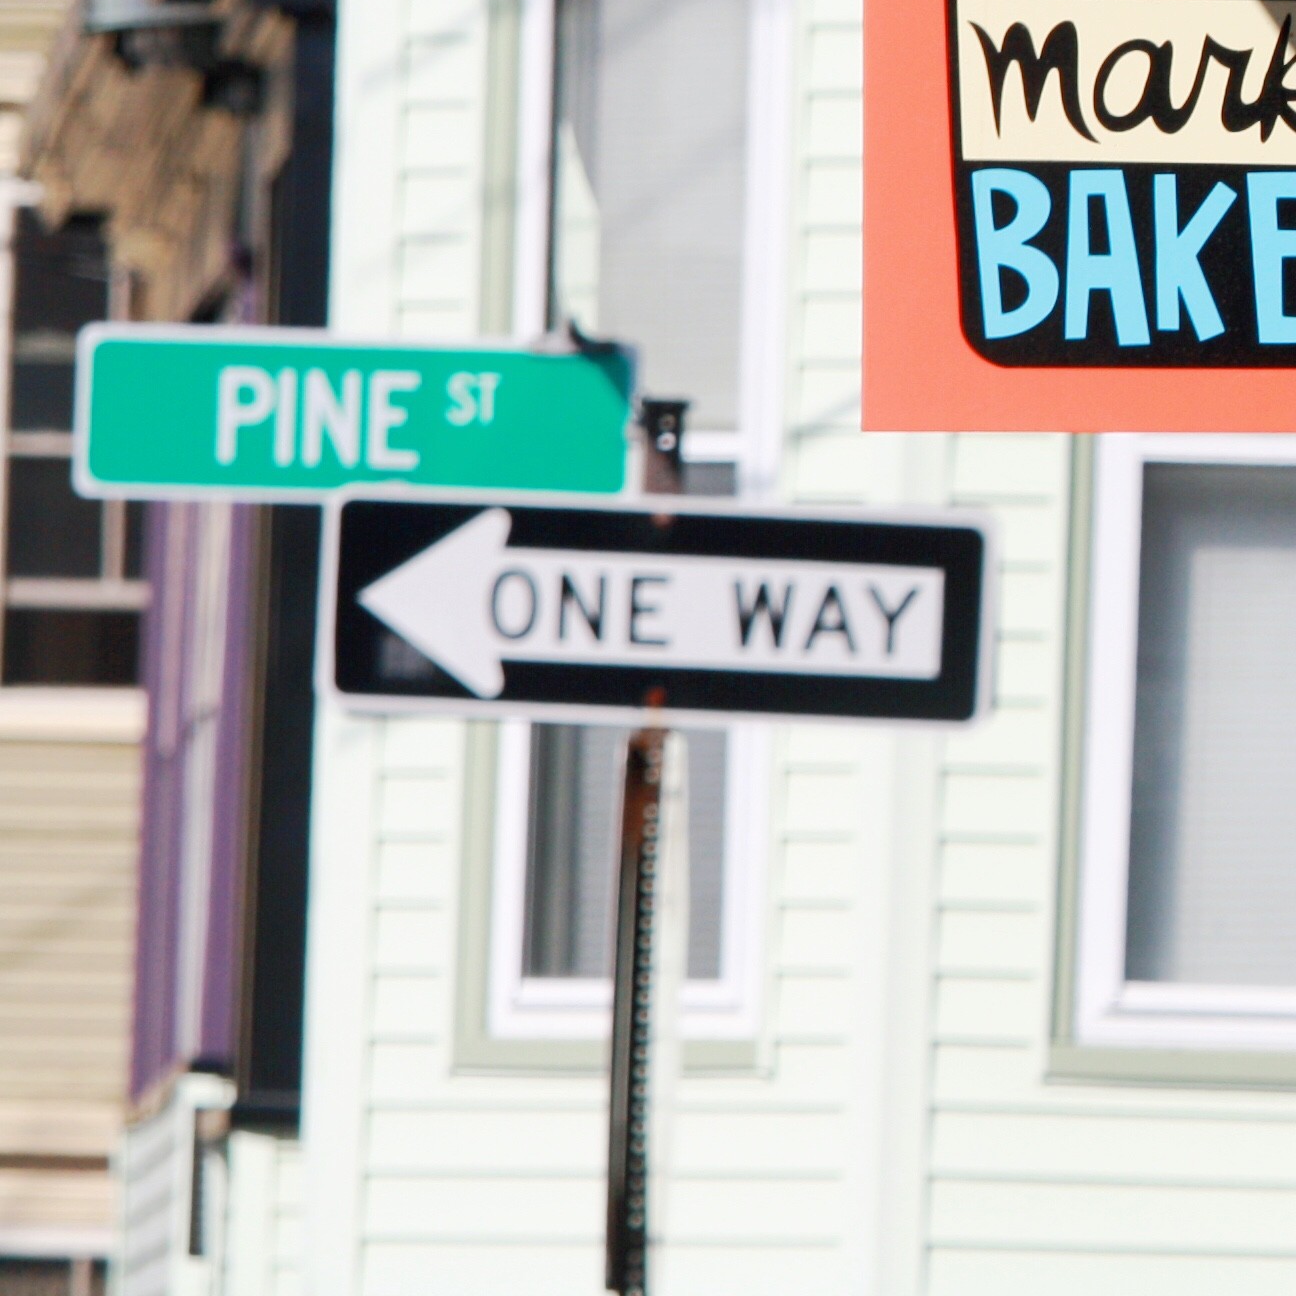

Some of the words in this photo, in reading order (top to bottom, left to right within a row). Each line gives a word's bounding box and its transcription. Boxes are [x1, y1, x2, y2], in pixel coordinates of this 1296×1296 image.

[214, 365, 422, 472] PINE
[445, 373, 502, 427] ST
[489, 566, 673, 648] ONE
[732, 578, 921, 656] WAY
